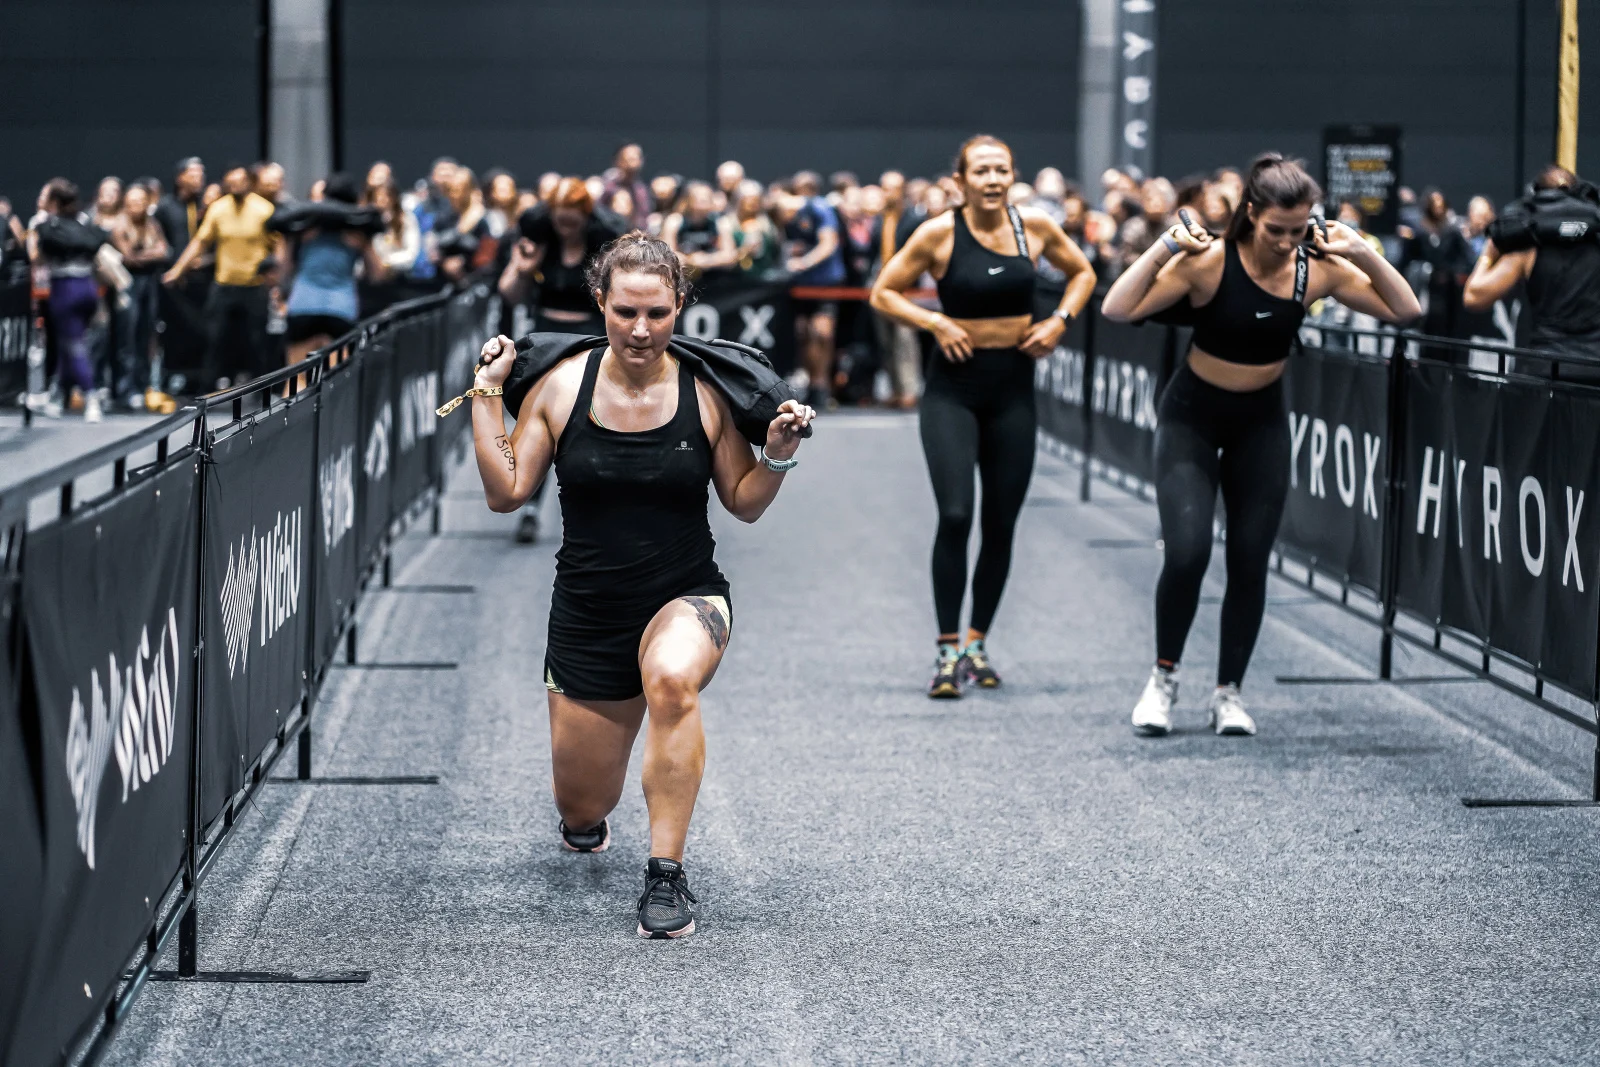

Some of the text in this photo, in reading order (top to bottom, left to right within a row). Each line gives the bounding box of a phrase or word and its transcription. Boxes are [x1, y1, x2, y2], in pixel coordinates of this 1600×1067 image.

[495, 434, 516, 471] 15109
[1289, 411, 1381, 520] YROX
[261, 506, 301, 647] WithU
[1416, 445, 1585, 593] HYROX
